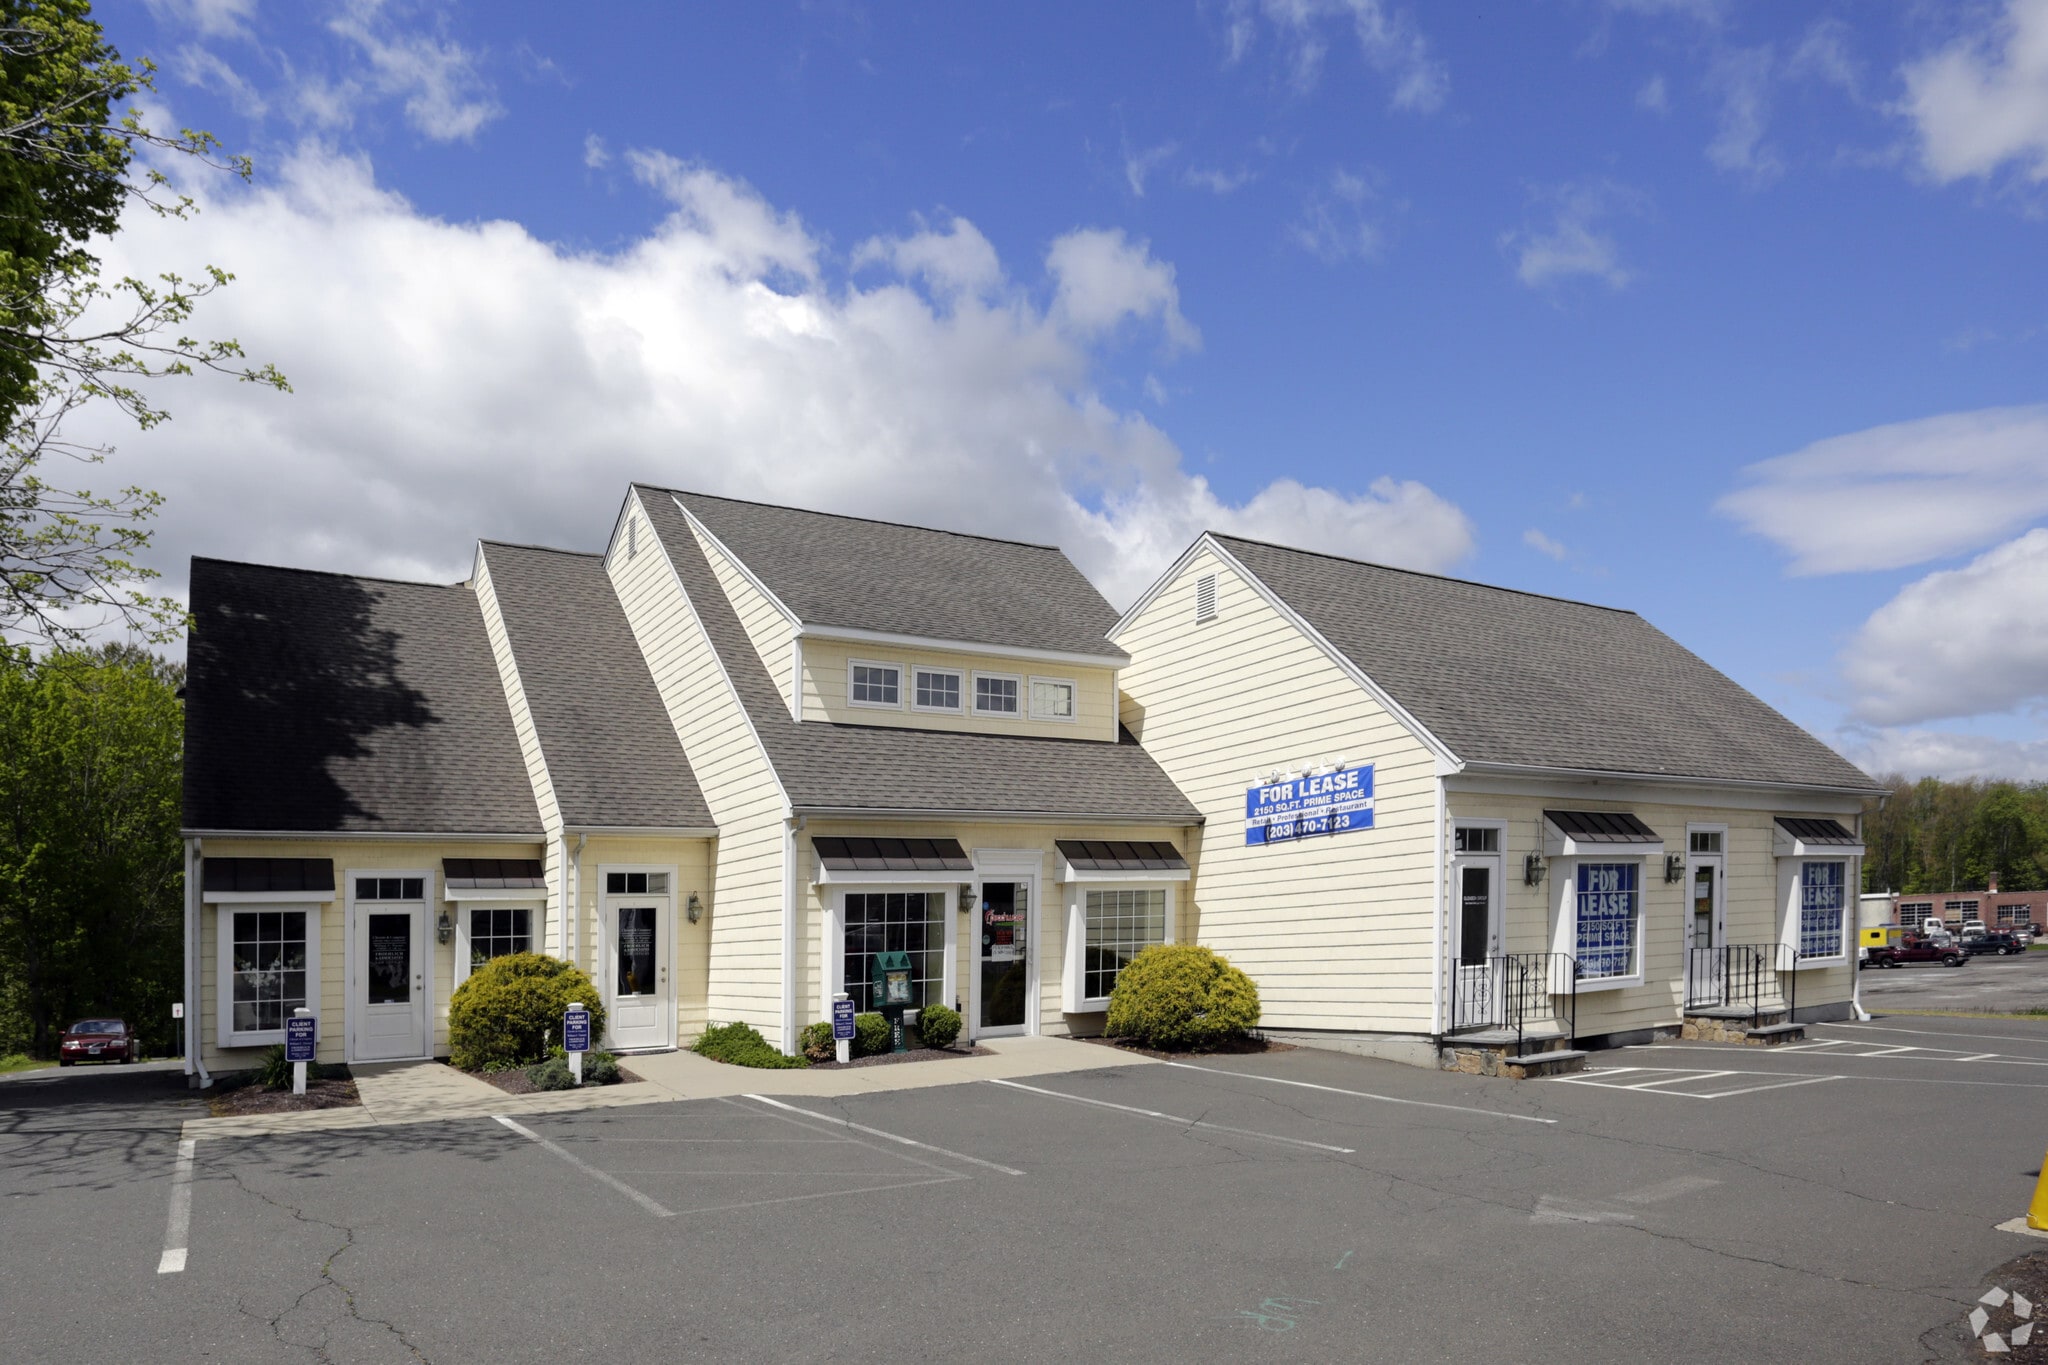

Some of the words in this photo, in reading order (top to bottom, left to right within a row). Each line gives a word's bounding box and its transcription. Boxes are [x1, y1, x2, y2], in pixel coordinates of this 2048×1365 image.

[1259, 784, 1293, 804] FOR
[1298, 771, 1359, 797] LEASE
[1254, 806, 1274, 816] 2150
[1275, 801, 1300, 813] SQ.FT.
[1303, 796, 1331, 808] PRIME
[1334, 788, 1365, 802] SPACE
[1276, 809, 1319, 822] Professional
[1325, 801, 1368, 814] Restaurant
[1266, 822, 1294, 840] (203)
[1295, 815, 1350, 834] 470-7123
[1589, 870, 1619, 891] FOR
[1809, 866, 1829, 885] FOR
[1581, 893, 1629, 916] LEASE
[1803, 886, 1837, 906] LEASE
[1581, 922, 1600, 932] 250
